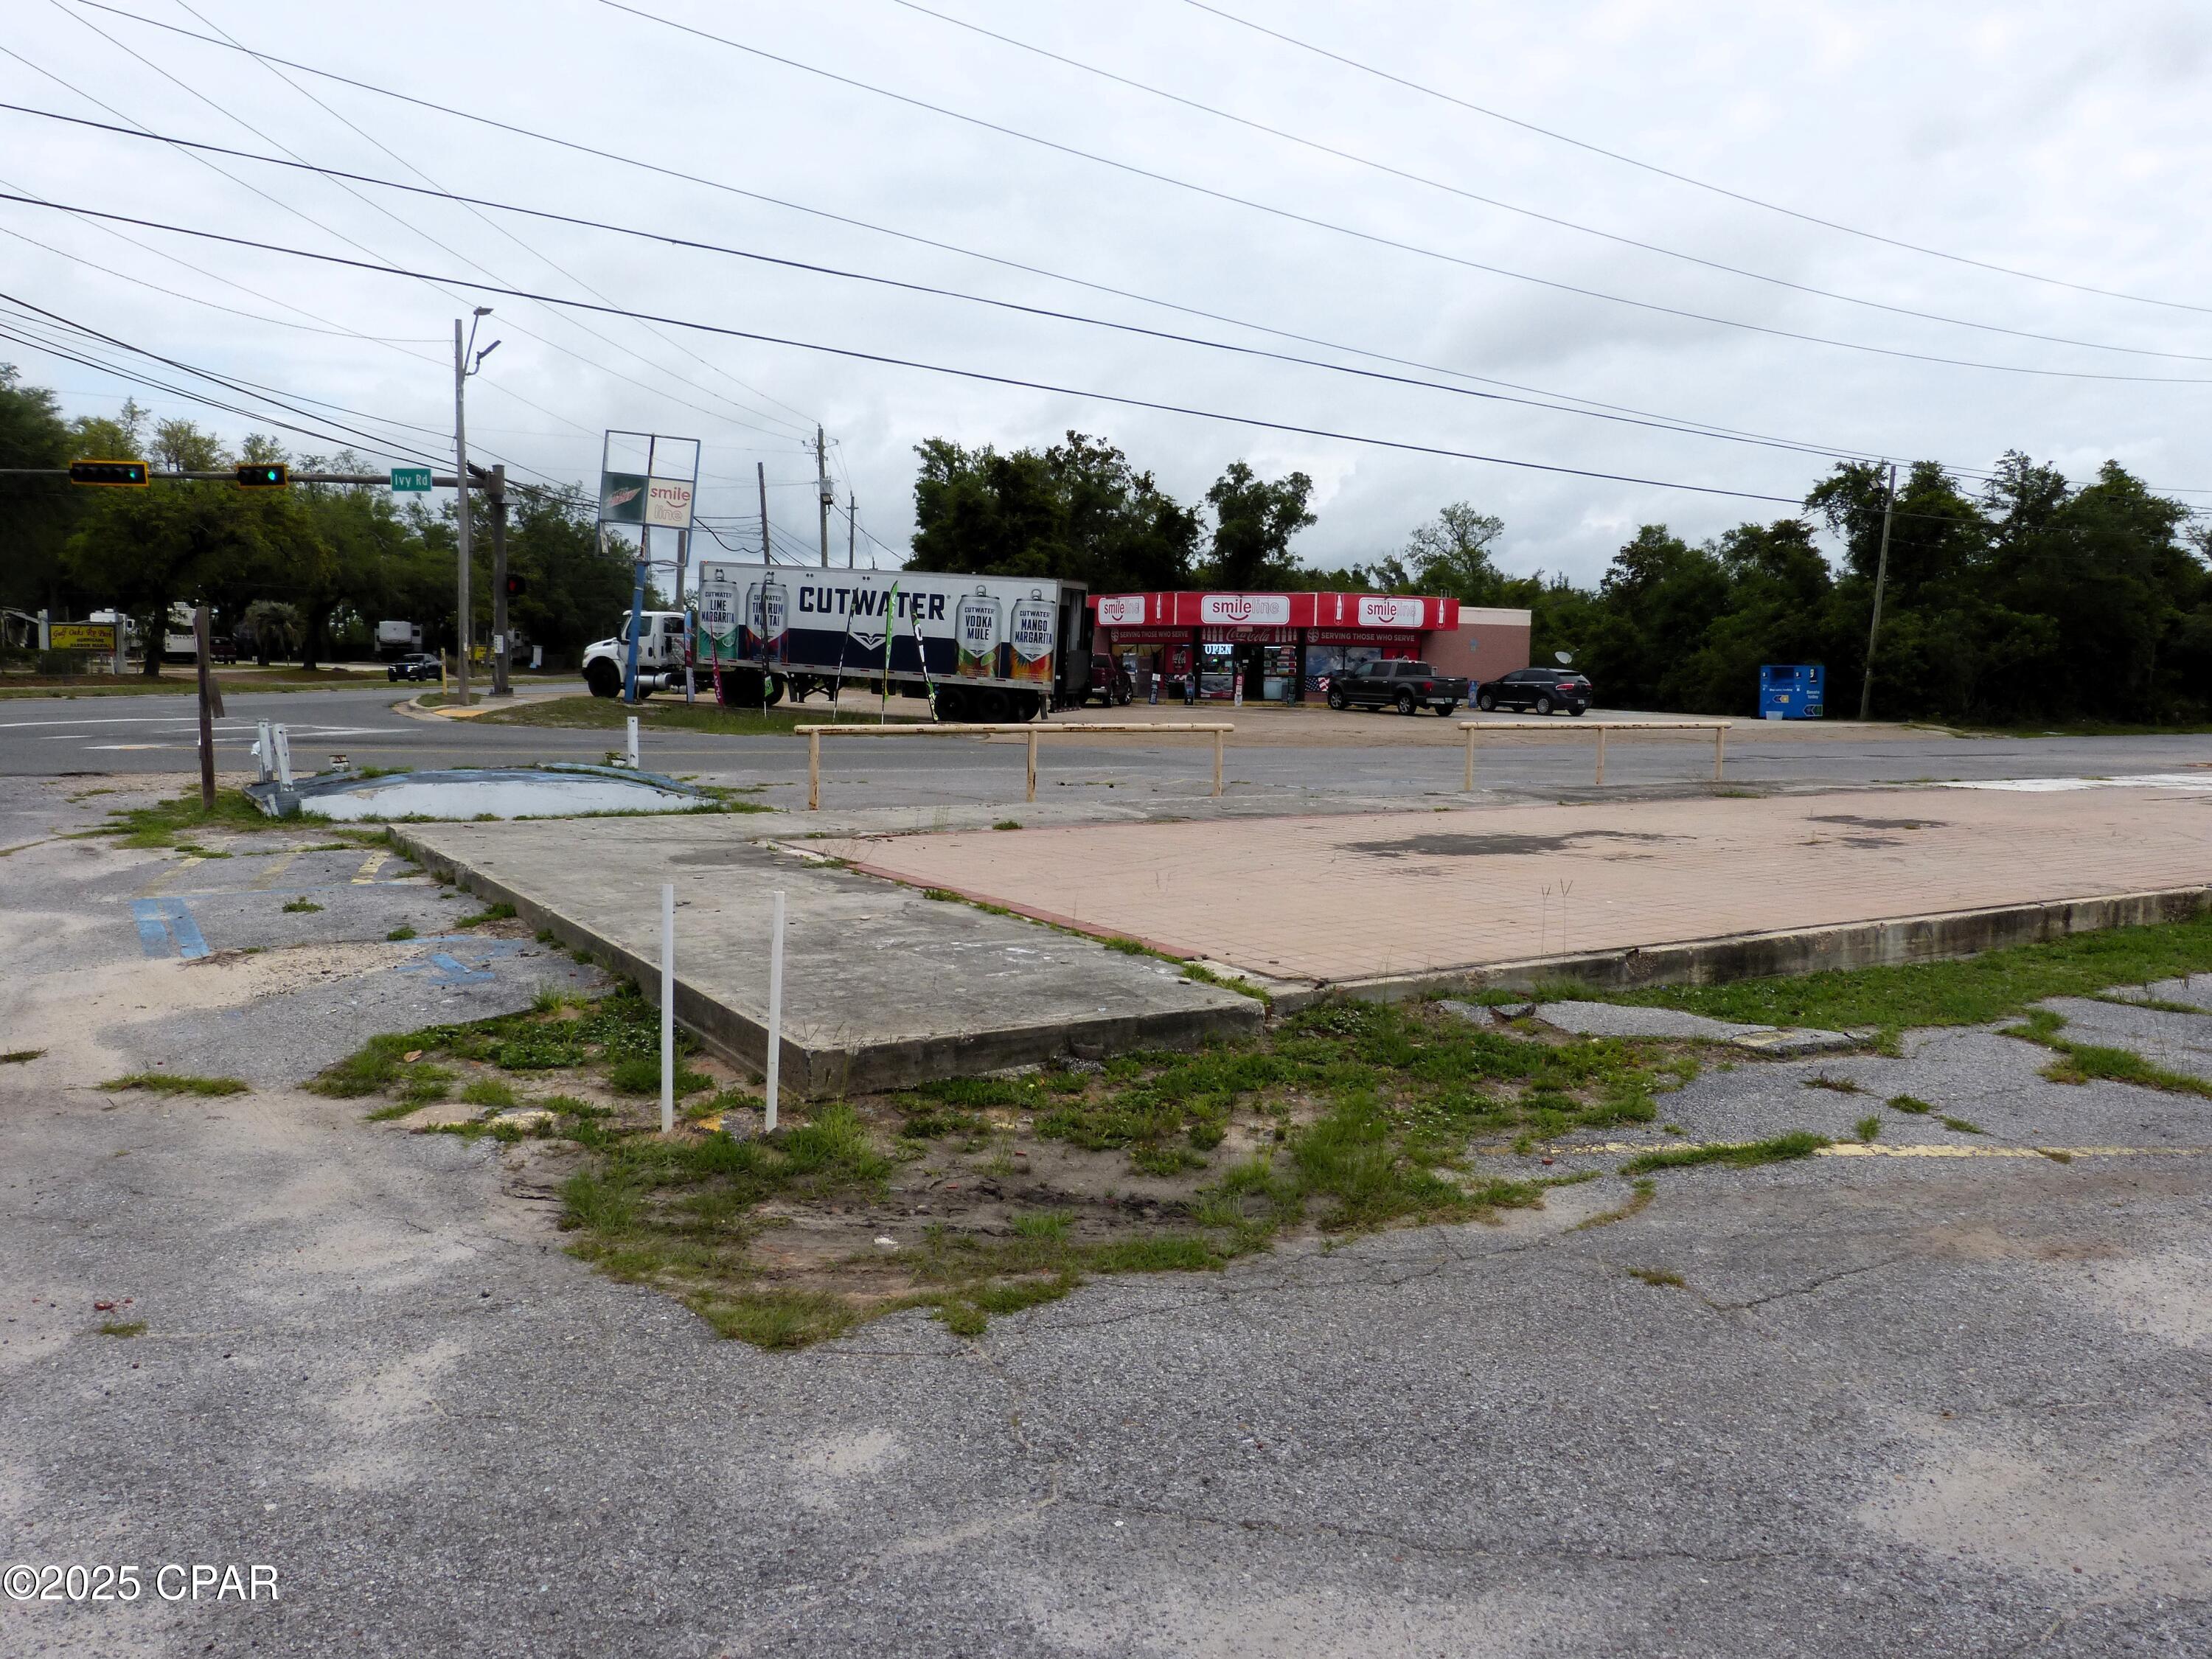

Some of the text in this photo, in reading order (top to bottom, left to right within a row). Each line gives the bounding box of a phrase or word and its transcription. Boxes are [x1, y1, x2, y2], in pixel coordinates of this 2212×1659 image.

[394, 474, 428, 487] Ivy Rd
[650, 487, 691, 501] smile
[654, 504, 683, 521] line
[710, 599, 726, 611] LIME
[768, 602, 783, 615] RUM
[799, 586, 945, 621] CUTWATER
[701, 611, 734, 624] MARGARITA
[769, 614, 779, 626] TAI
[965, 615, 992, 628] VODKA
[1020, 619, 1048, 632] MANGO
[967, 627, 990, 640] MULE
[1015, 631, 1052, 645] MARGARITA
[1321, 632, 1415, 641] SERVING THOSE WHO SERVE
[1204, 645, 1232, 655] OPEN
